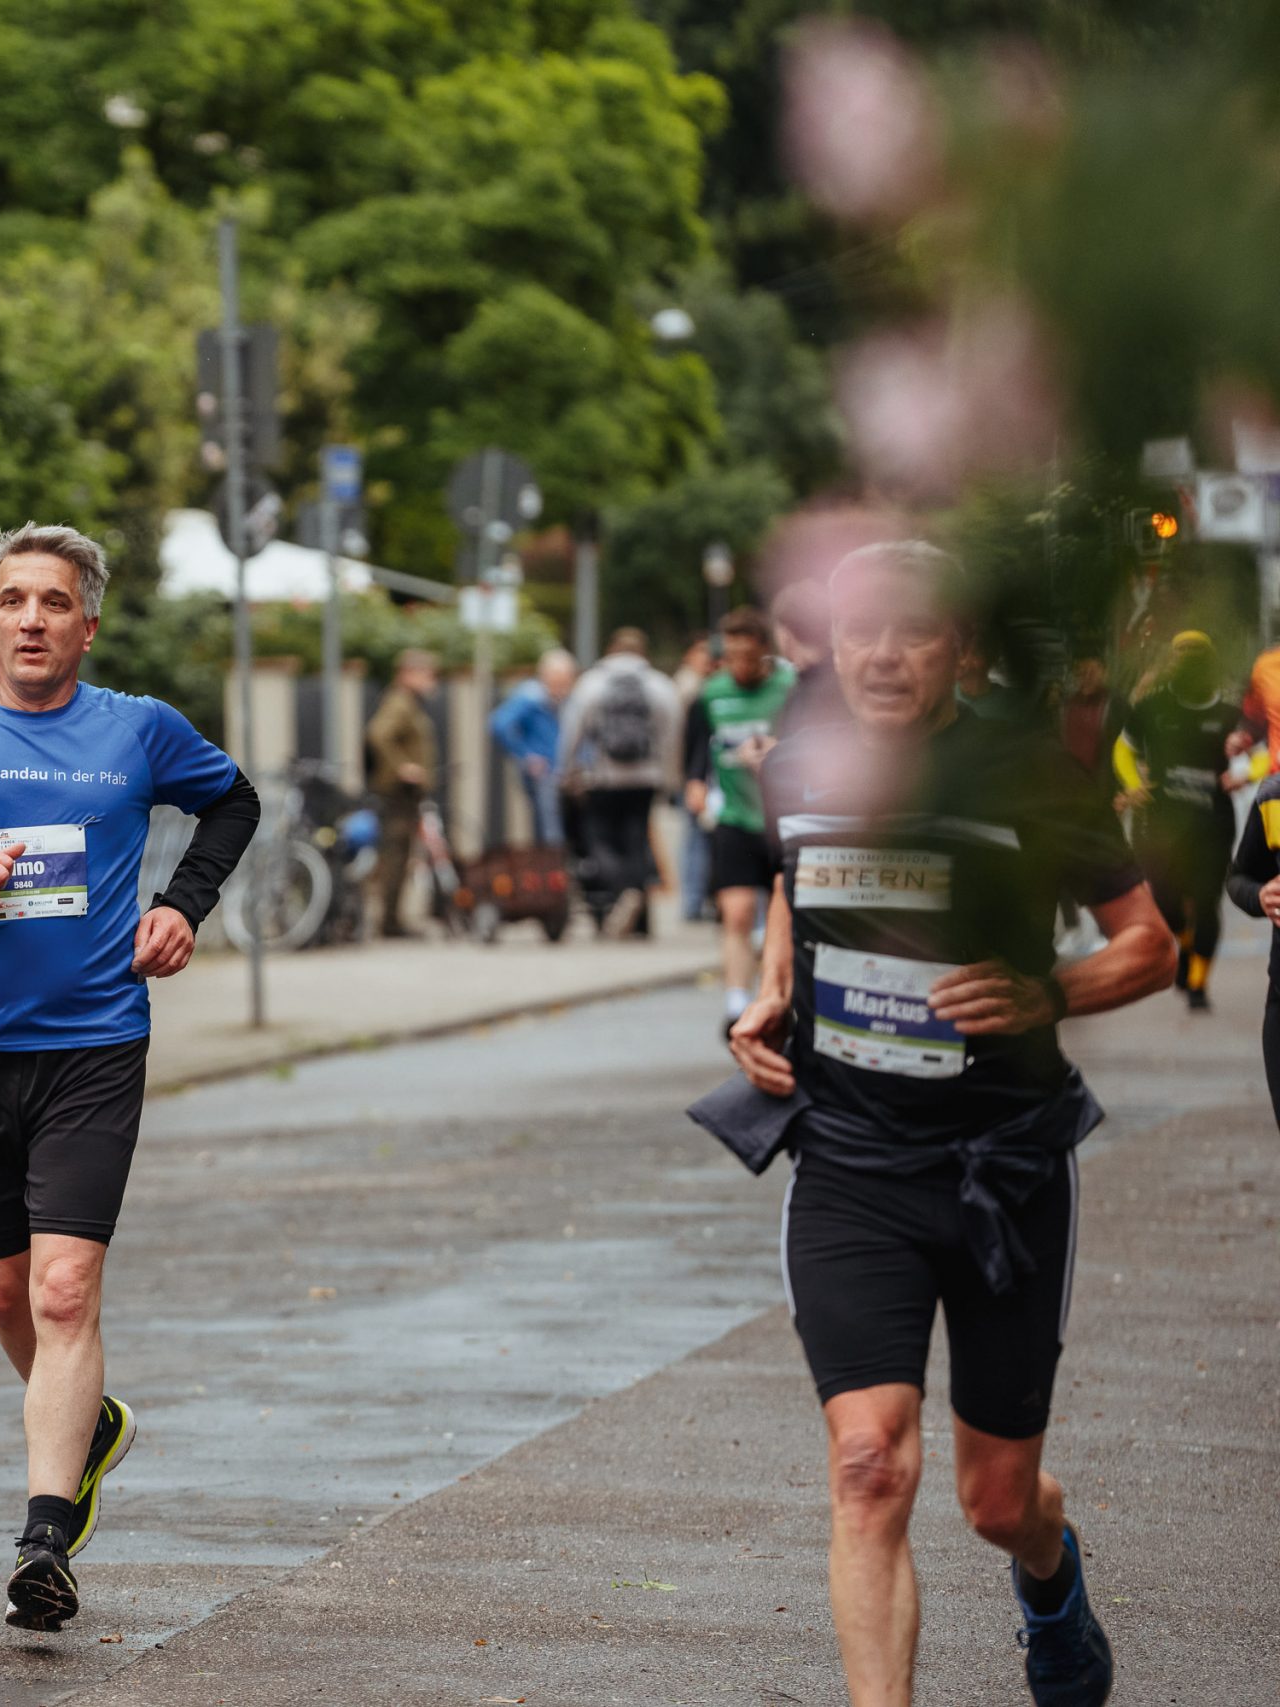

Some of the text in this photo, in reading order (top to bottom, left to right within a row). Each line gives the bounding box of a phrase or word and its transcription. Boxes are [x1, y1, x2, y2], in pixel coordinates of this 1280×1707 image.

[54, 769, 66, 781] in
[72, 770, 95, 783] der
[100, 771, 127, 786] Pfalz
[12, 860, 45, 876] imo
[14, 881, 33, 889] 5840
[814, 867, 925, 889] STERN
[844, 988, 929, 1023] Markus
